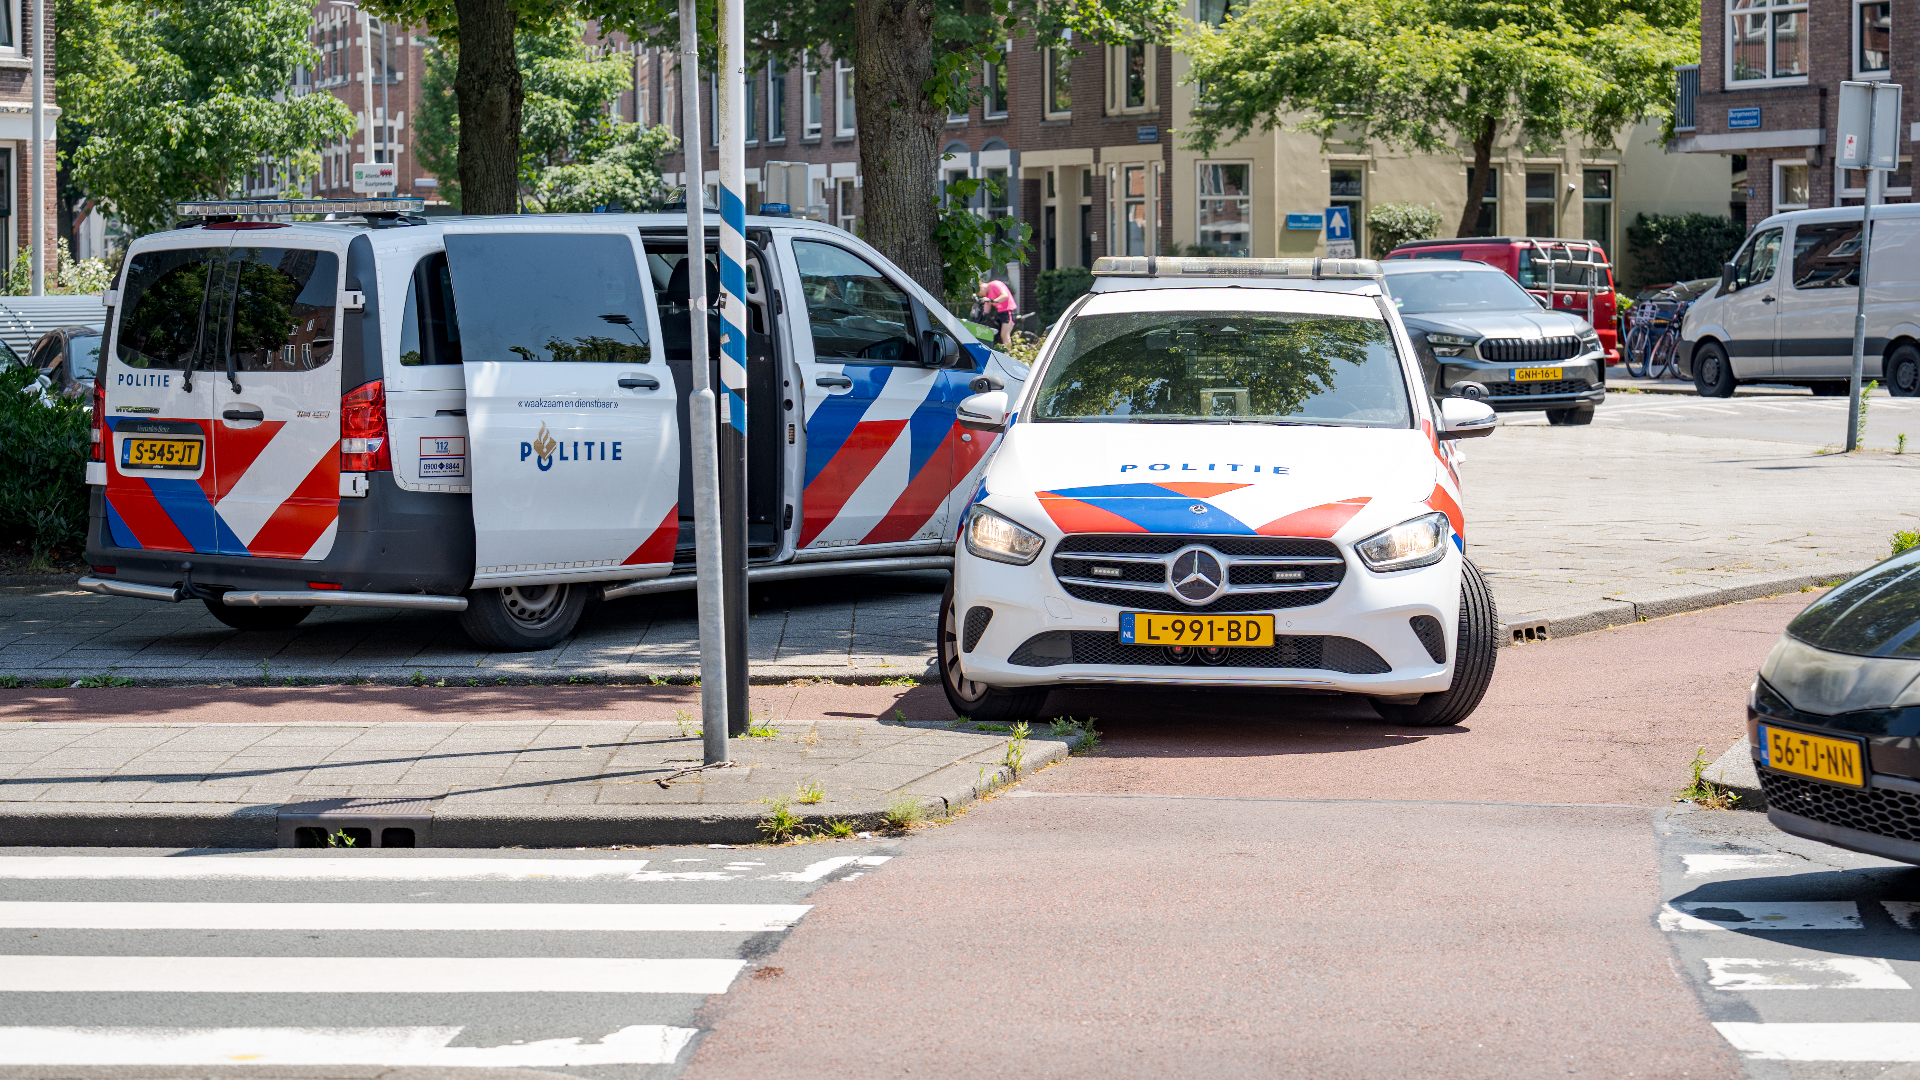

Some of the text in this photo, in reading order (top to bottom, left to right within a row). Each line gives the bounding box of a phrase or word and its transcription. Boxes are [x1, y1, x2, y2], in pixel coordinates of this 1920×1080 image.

[1730, 110, 1758, 118] Burgemeester
[1518, 369, 1559, 379] GNH-16-L
[118, 373, 170, 387] POLITIE
[524, 398, 564, 408] waakzaam
[574, 398, 613, 408] dienstbaar
[435, 441, 449, 451] 112
[135, 442, 195, 463] S-545-JT
[520, 441, 622, 472] POLITIE
[423, 462, 460, 471] 0900 8844
[1120, 463, 1290, 475] POLITIE
[1122, 631, 1133, 639] NL
[1147, 618, 1261, 642] L-991-BD
[1773, 733, 1854, 779] 56-TJ-NN
